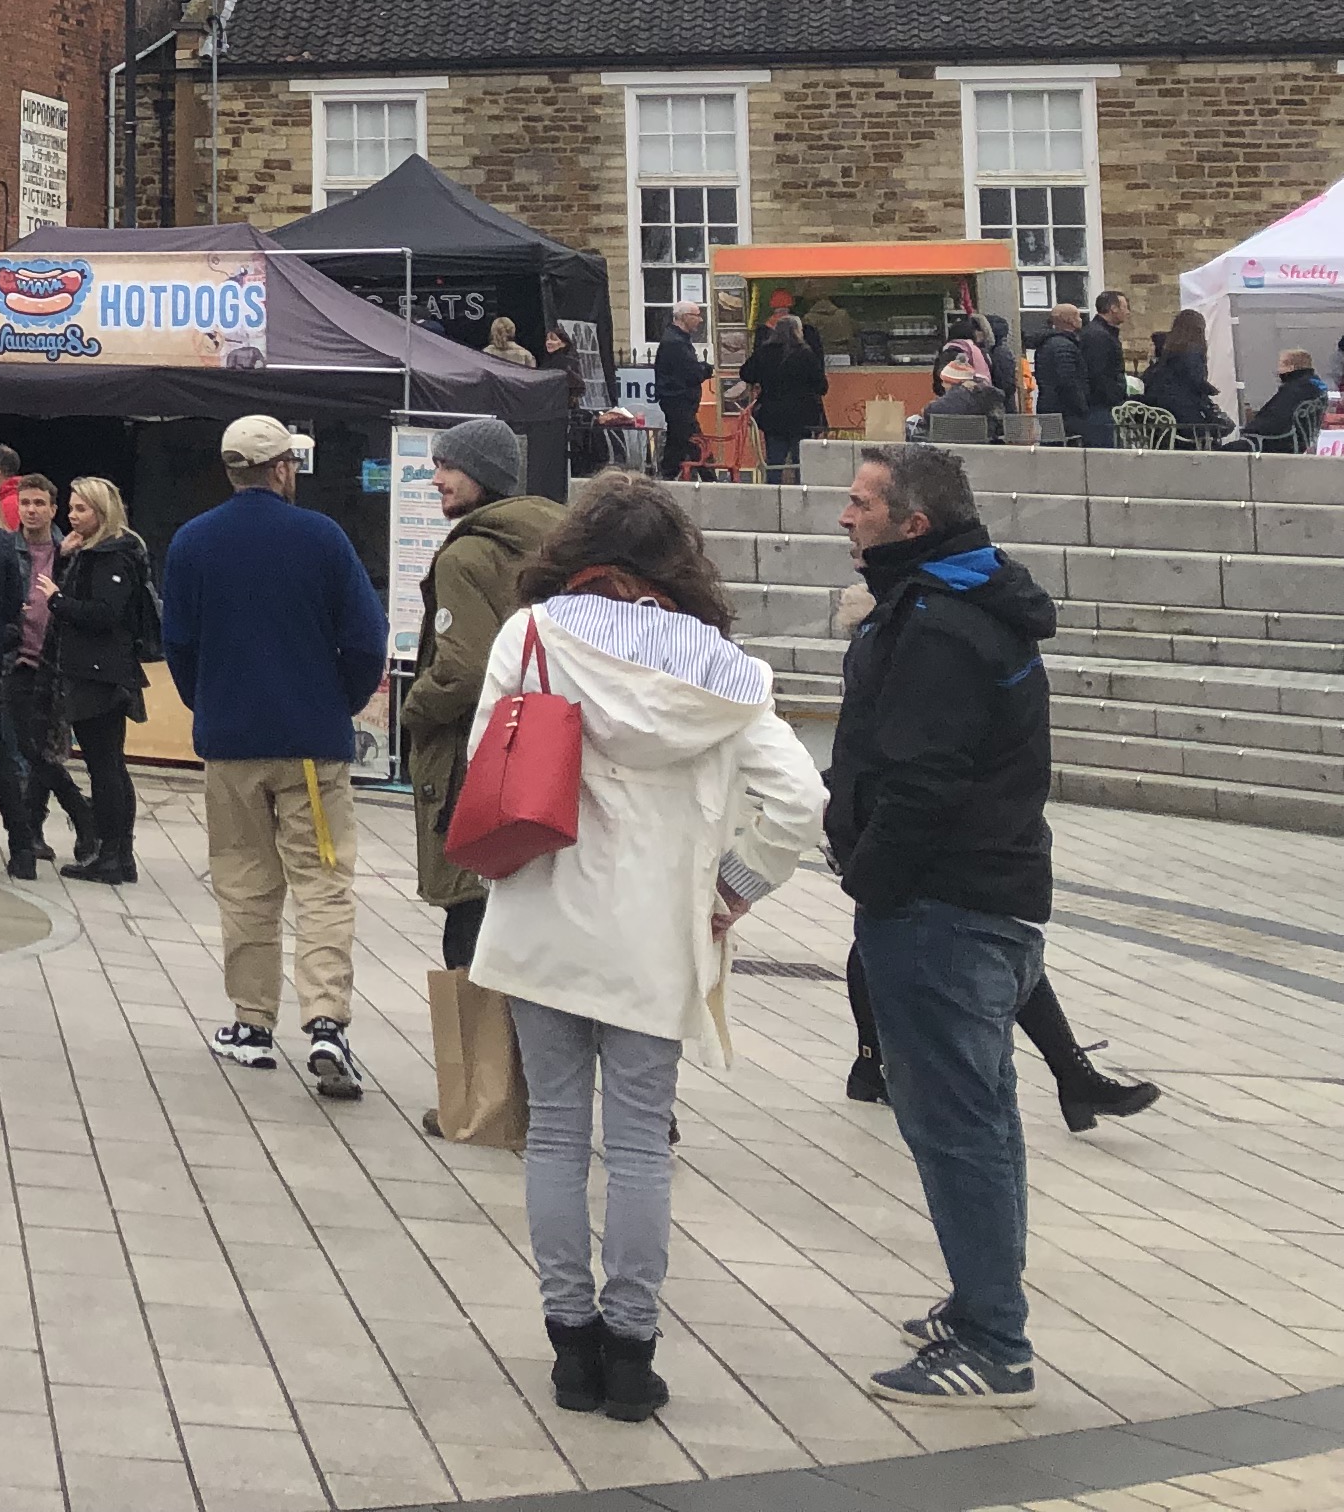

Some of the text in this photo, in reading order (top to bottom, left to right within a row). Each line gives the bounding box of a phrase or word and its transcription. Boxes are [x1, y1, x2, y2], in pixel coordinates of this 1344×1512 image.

[22, 186, 61, 210] PICTURES
[101, 283, 265, 329] HOTDOGS
[398, 292, 485, 320] EATS
